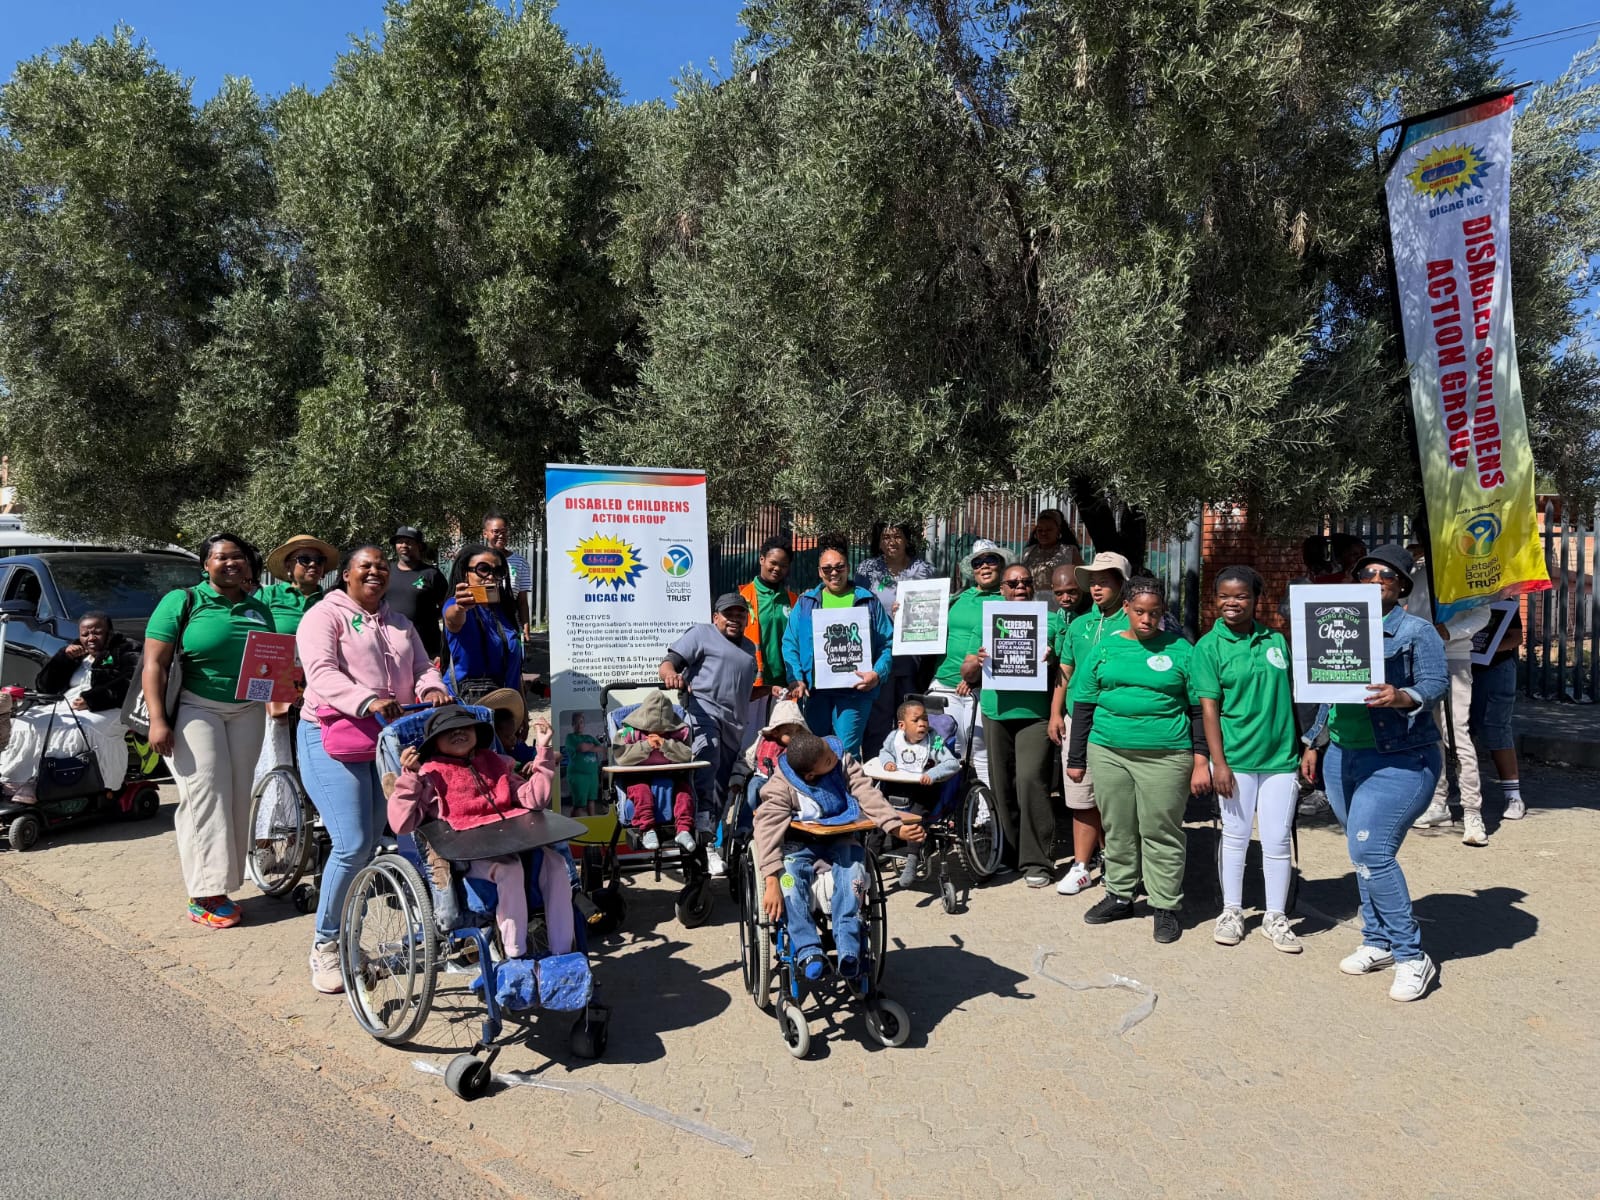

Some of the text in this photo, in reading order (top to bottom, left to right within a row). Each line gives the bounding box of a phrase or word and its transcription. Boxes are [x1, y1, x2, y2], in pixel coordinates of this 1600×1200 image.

[1429, 195, 1484, 219] DICAG NC
[1462, 214, 1496, 340] DISABLED
[1427, 258, 1470, 469] ACTION GROUP
[565, 498, 690, 513] DISABLED CHILDRENS
[592, 513, 666, 524] ACTION GROUP
[1467, 572, 1502, 589] TRUST
[585, 594, 635, 602] DICAG NC
[1317, 613, 1337, 625] BEING
[1344, 613, 1360, 625] MOM
[585, 621, 632, 629] organisation's
[650, 620, 679, 628] objective
[1004, 620, 1034, 630] CEREBRAL
[566, 628, 576, 636] (a)
[1009, 630, 1028, 638] PALSY
[1319, 623, 1360, 639] Choice
[585, 641, 633, 650] Organisation's
[634, 641, 668, 649] secondary
[572, 656, 601, 664] Conduct
[602, 656, 615, 664] HIV,
[1003, 654, 1027, 665] A MOM
[572, 663, 602, 671] increase
[603, 662, 645, 670] accessibility
[572, 671, 602, 679] Respond
[611, 669, 630, 677] GBVF
